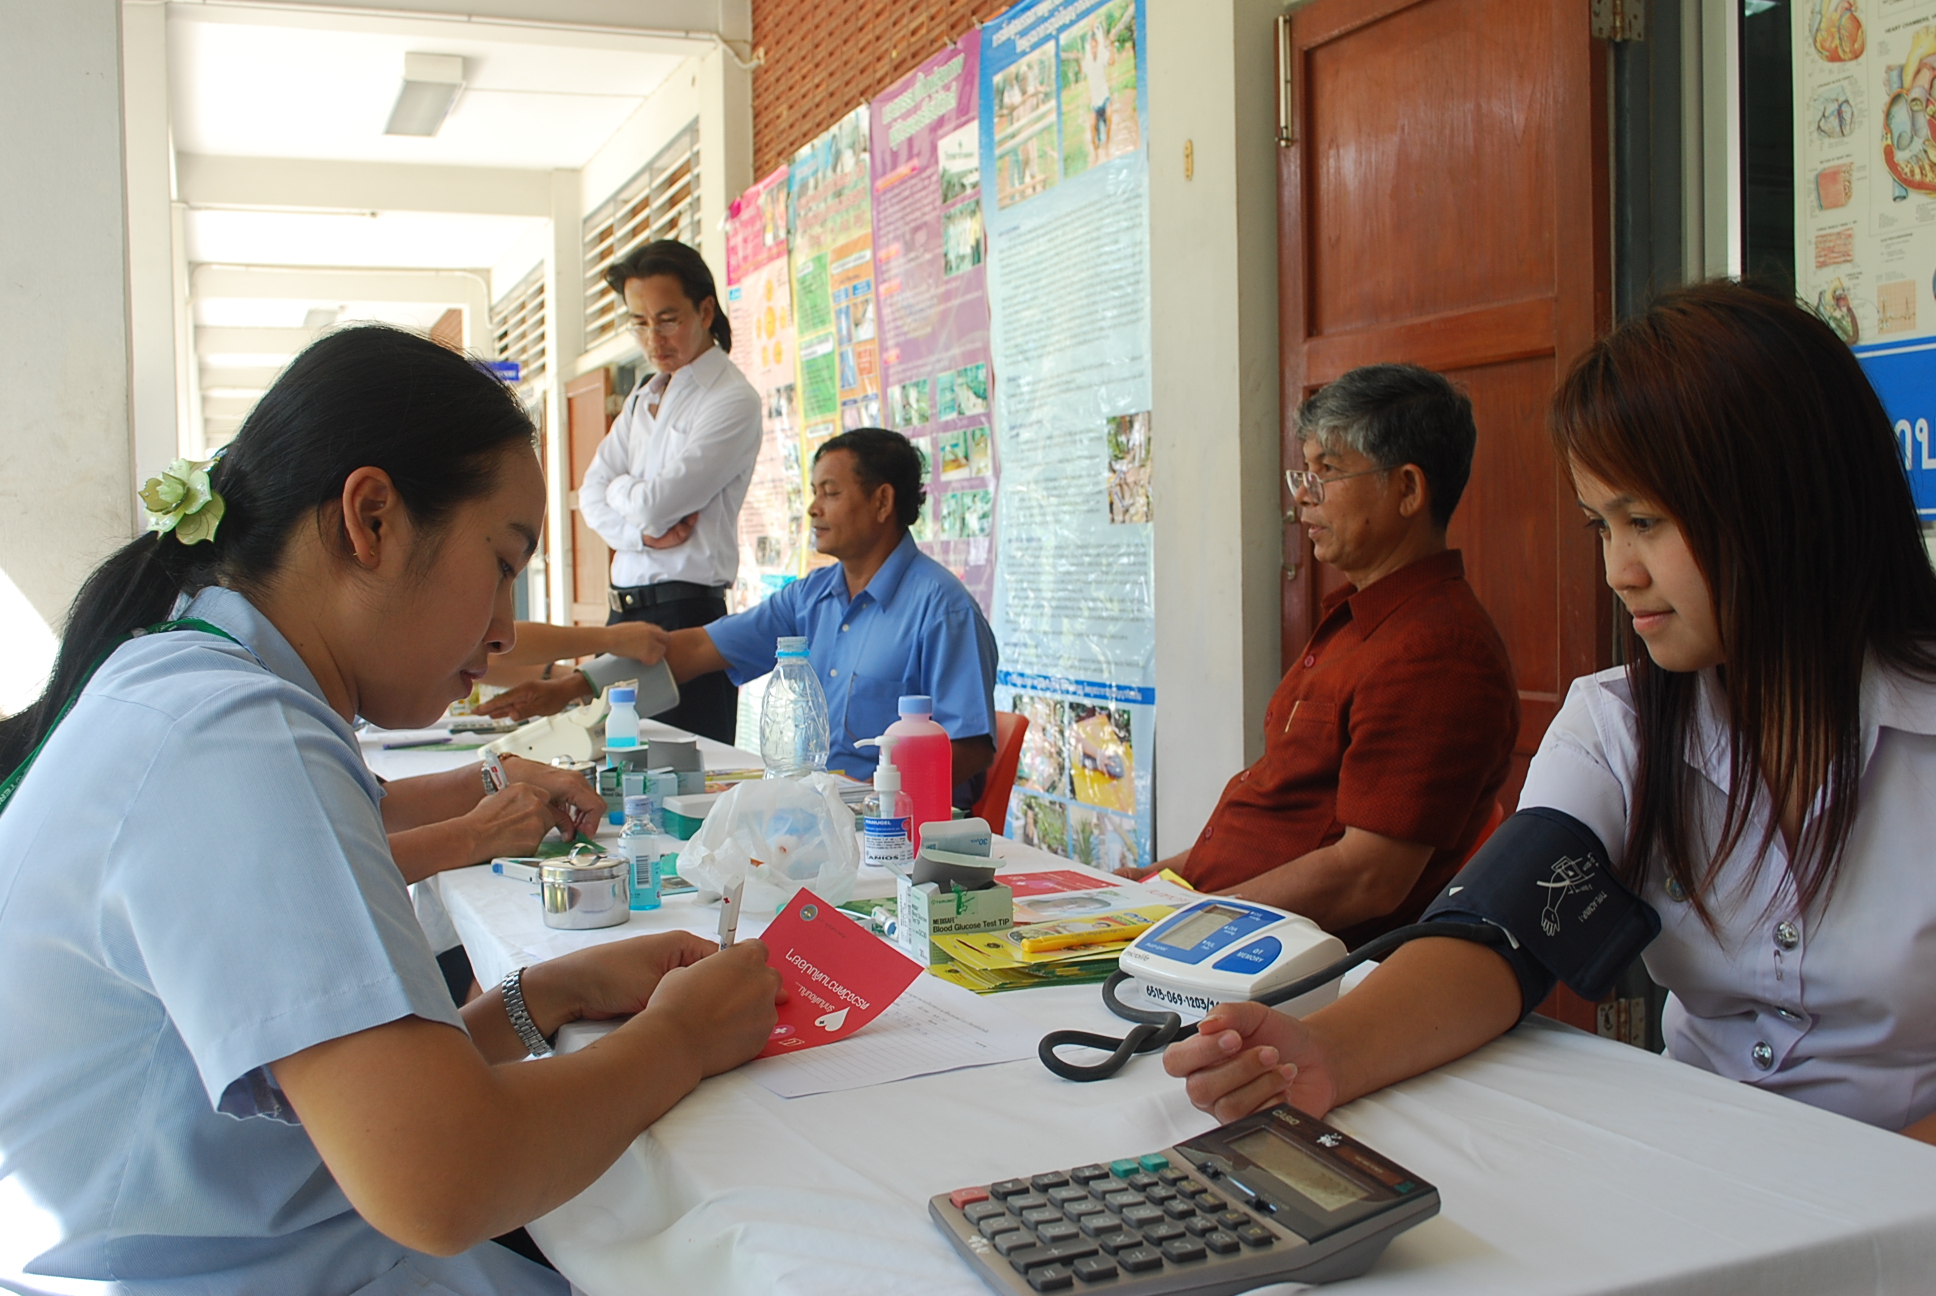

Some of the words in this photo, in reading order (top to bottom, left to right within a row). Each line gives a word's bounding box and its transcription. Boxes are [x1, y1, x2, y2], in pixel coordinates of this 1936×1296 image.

[932, 924, 953, 933] Blood
[954, 921, 982, 931] Glucose
[982, 919, 997, 928] Test
[998, 918, 1010, 926] TIP
[1124, 950, 1150, 962] microlife
[1236, 951, 1264, 963] MEMORY
[1271, 1109, 1300, 1126] CASIO
